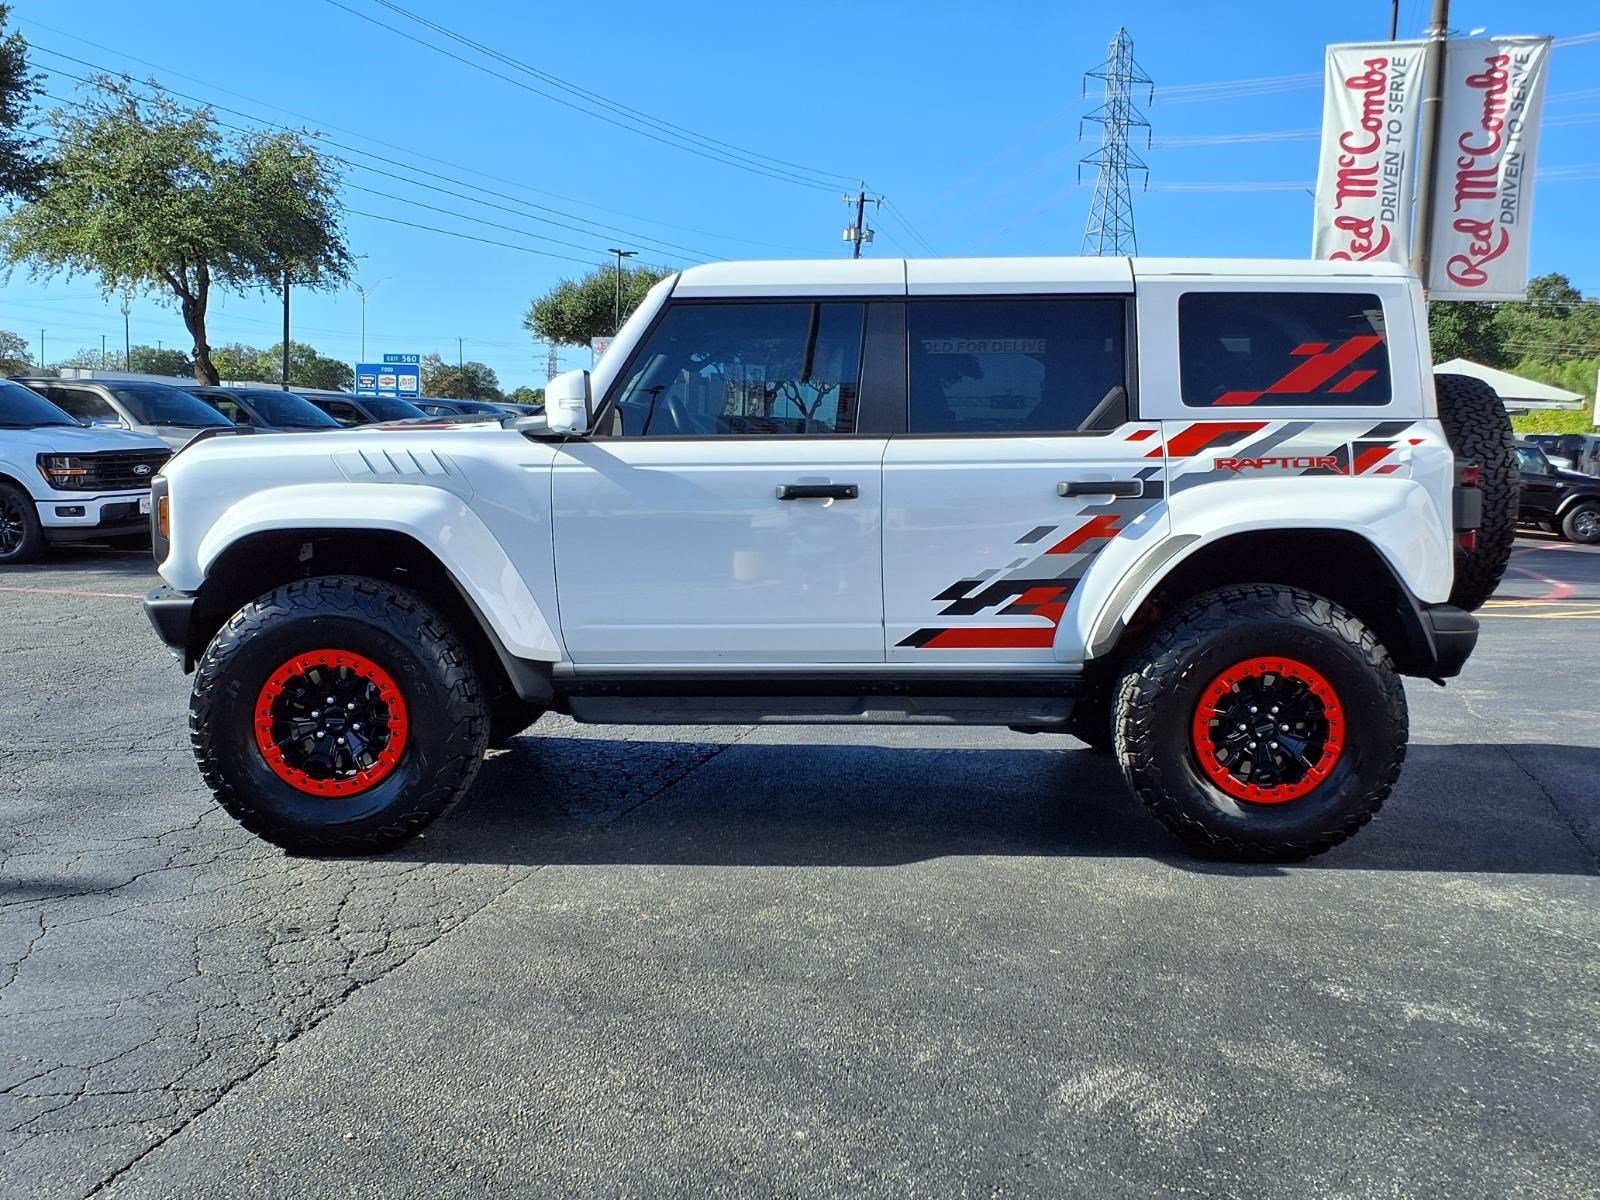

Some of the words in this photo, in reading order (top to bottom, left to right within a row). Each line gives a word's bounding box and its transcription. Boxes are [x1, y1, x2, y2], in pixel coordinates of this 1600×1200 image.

[1388, 57, 1407, 114] SERVE
[1510, 53, 1530, 112] SERVE
[1334, 57, 1389, 210] McCombs
[1386, 119, 1402, 146] TO
[1453, 54, 1510, 212] McCombs
[1508, 118, 1525, 146] TO
[1380, 151, 1400, 223] DRIVEN
[1500, 151, 1520, 225] DRIVEN
[1446, 217, 1509, 288] Red
[401, 355, 417, 363] 560
[1213, 456, 1344, 474] RAPTOR
